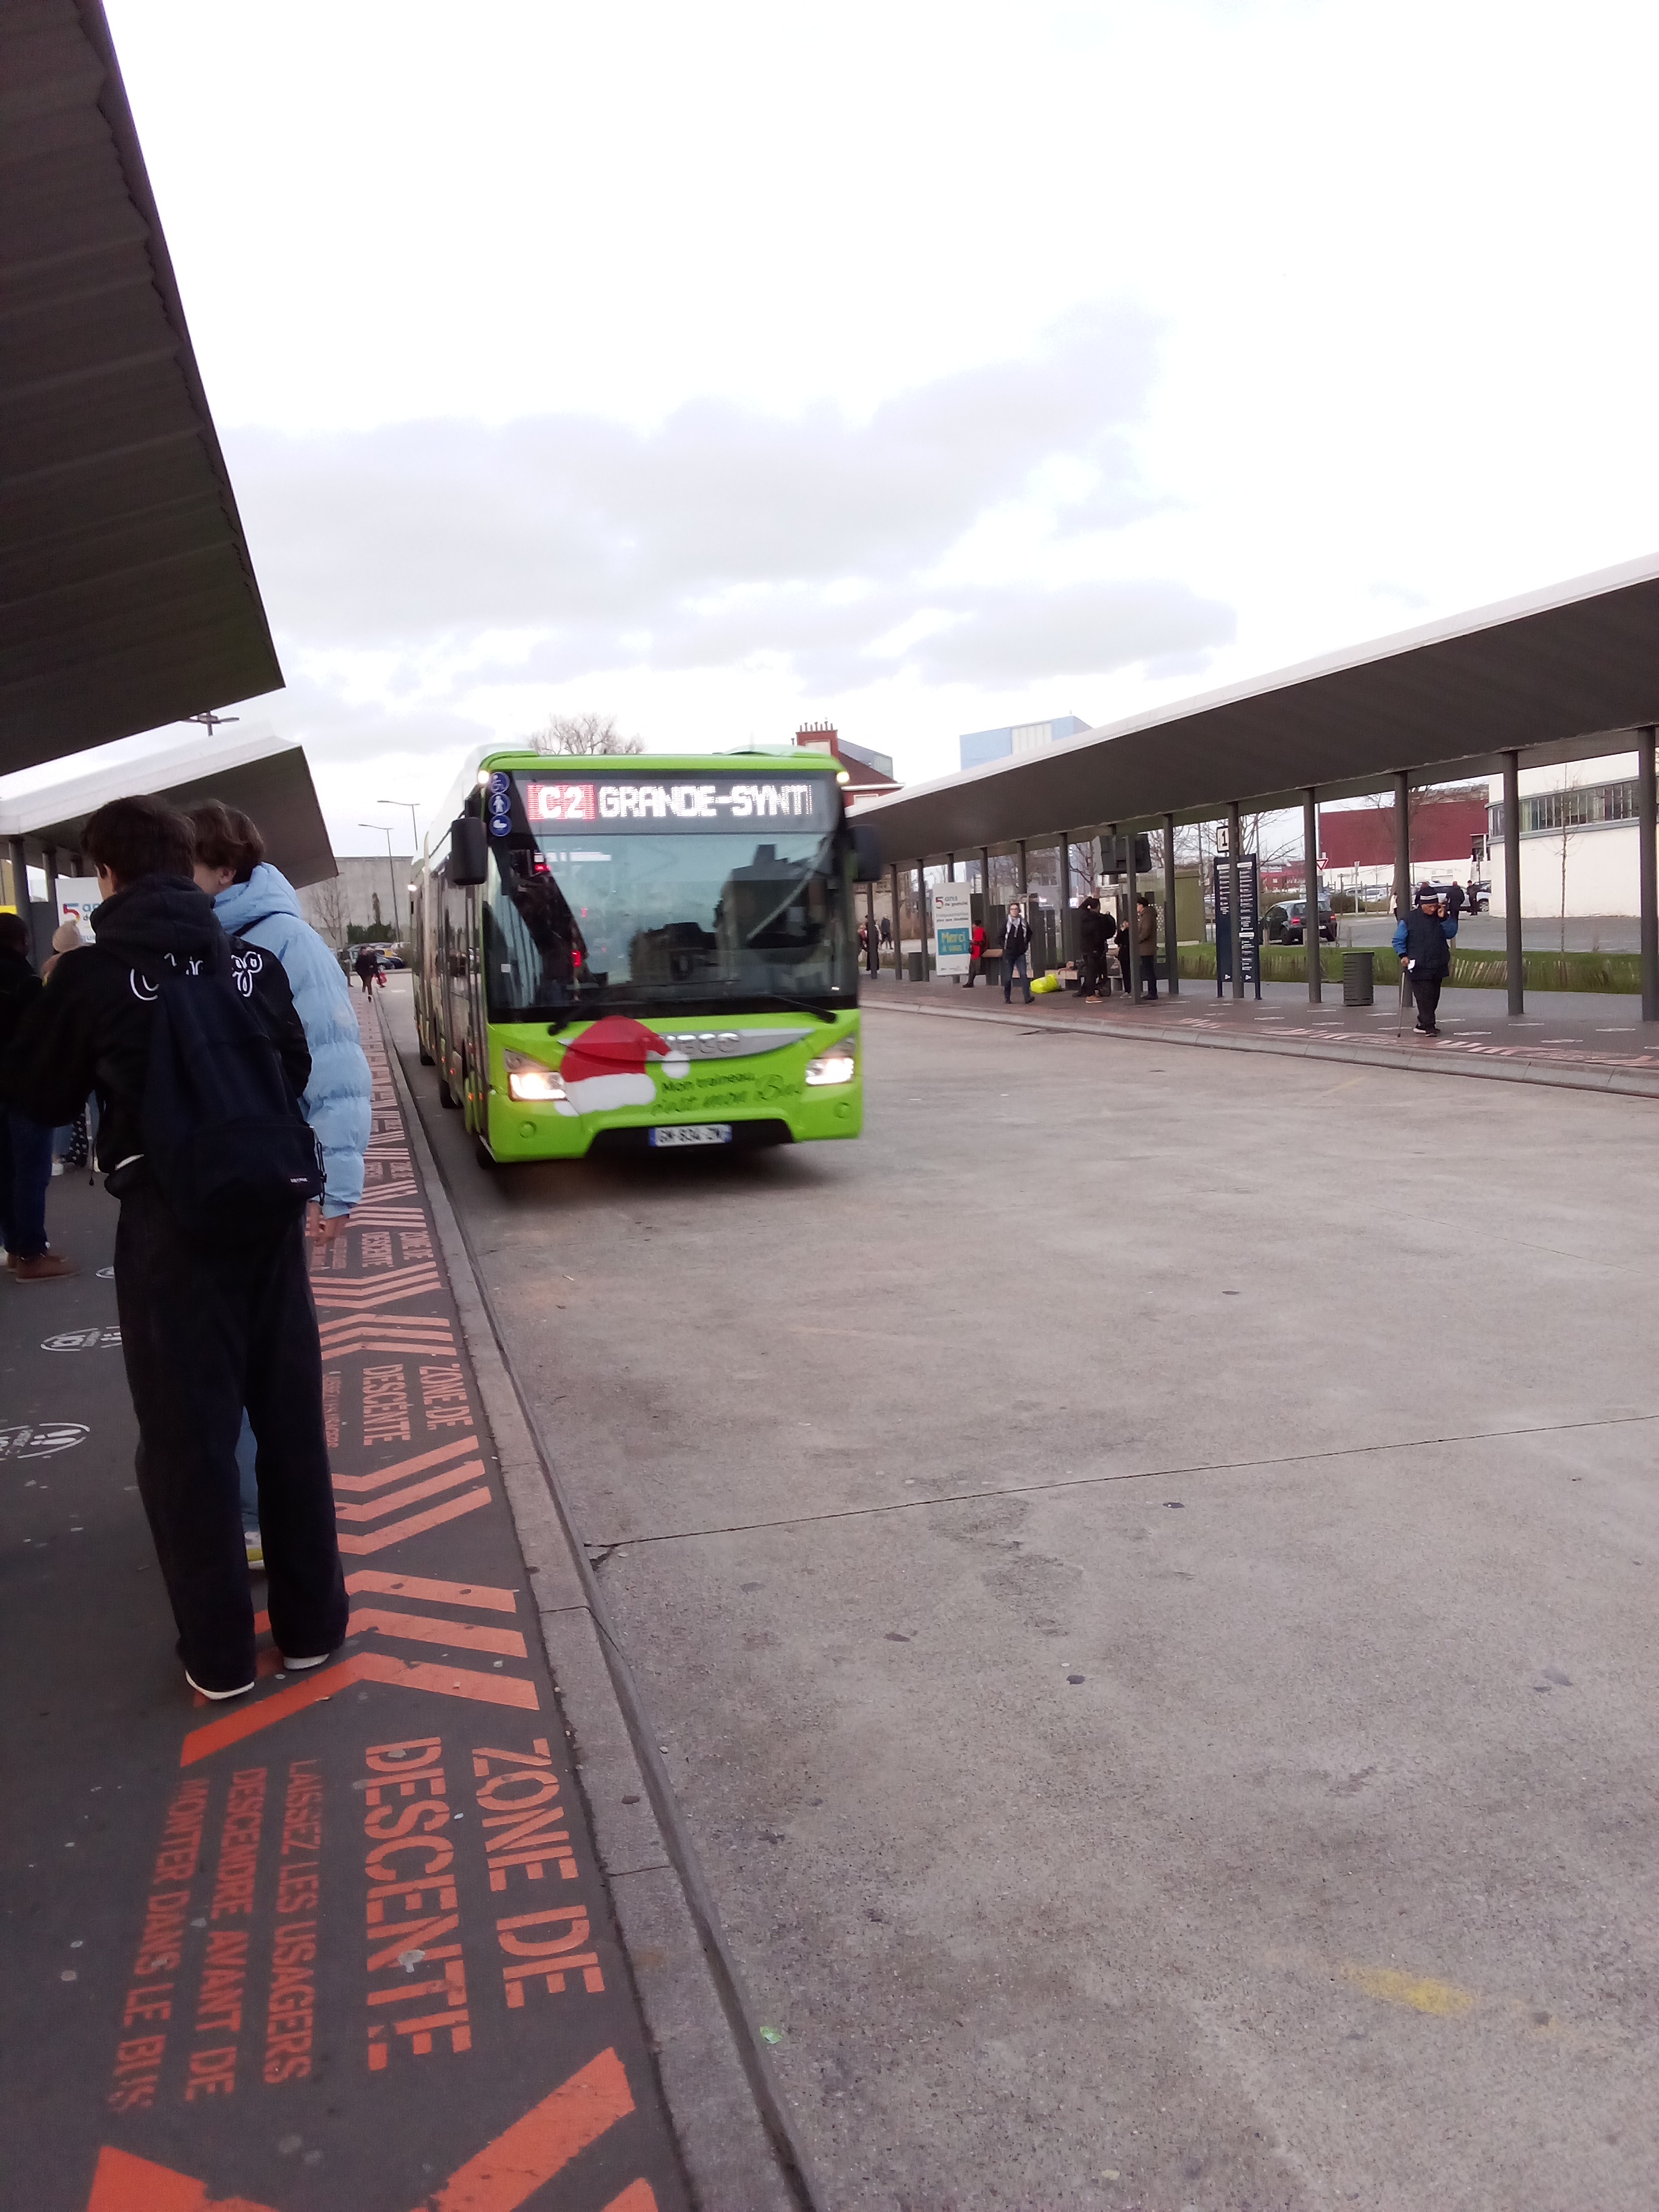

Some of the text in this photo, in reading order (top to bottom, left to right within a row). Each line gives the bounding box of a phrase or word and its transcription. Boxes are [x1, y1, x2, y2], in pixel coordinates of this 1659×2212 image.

[539, 785, 586, 819] C2
[1221, 830, 1228, 846] 1
[935, 897, 943, 909] 5
[363, 1364, 411, 1446] DESCENTE
[419, 1363, 474, 1430] ZONE DE
[107, 1779, 210, 2113] MONTER DANS LE BUS
[184, 1768, 267, 2102] DESCENDRE AVANT DE
[263, 1760, 323, 2083] LAISSEZ LES USAGERS
[364, 1736, 472, 2071] DESCENTE
[472, 1738, 605, 2009] ZONE DE
